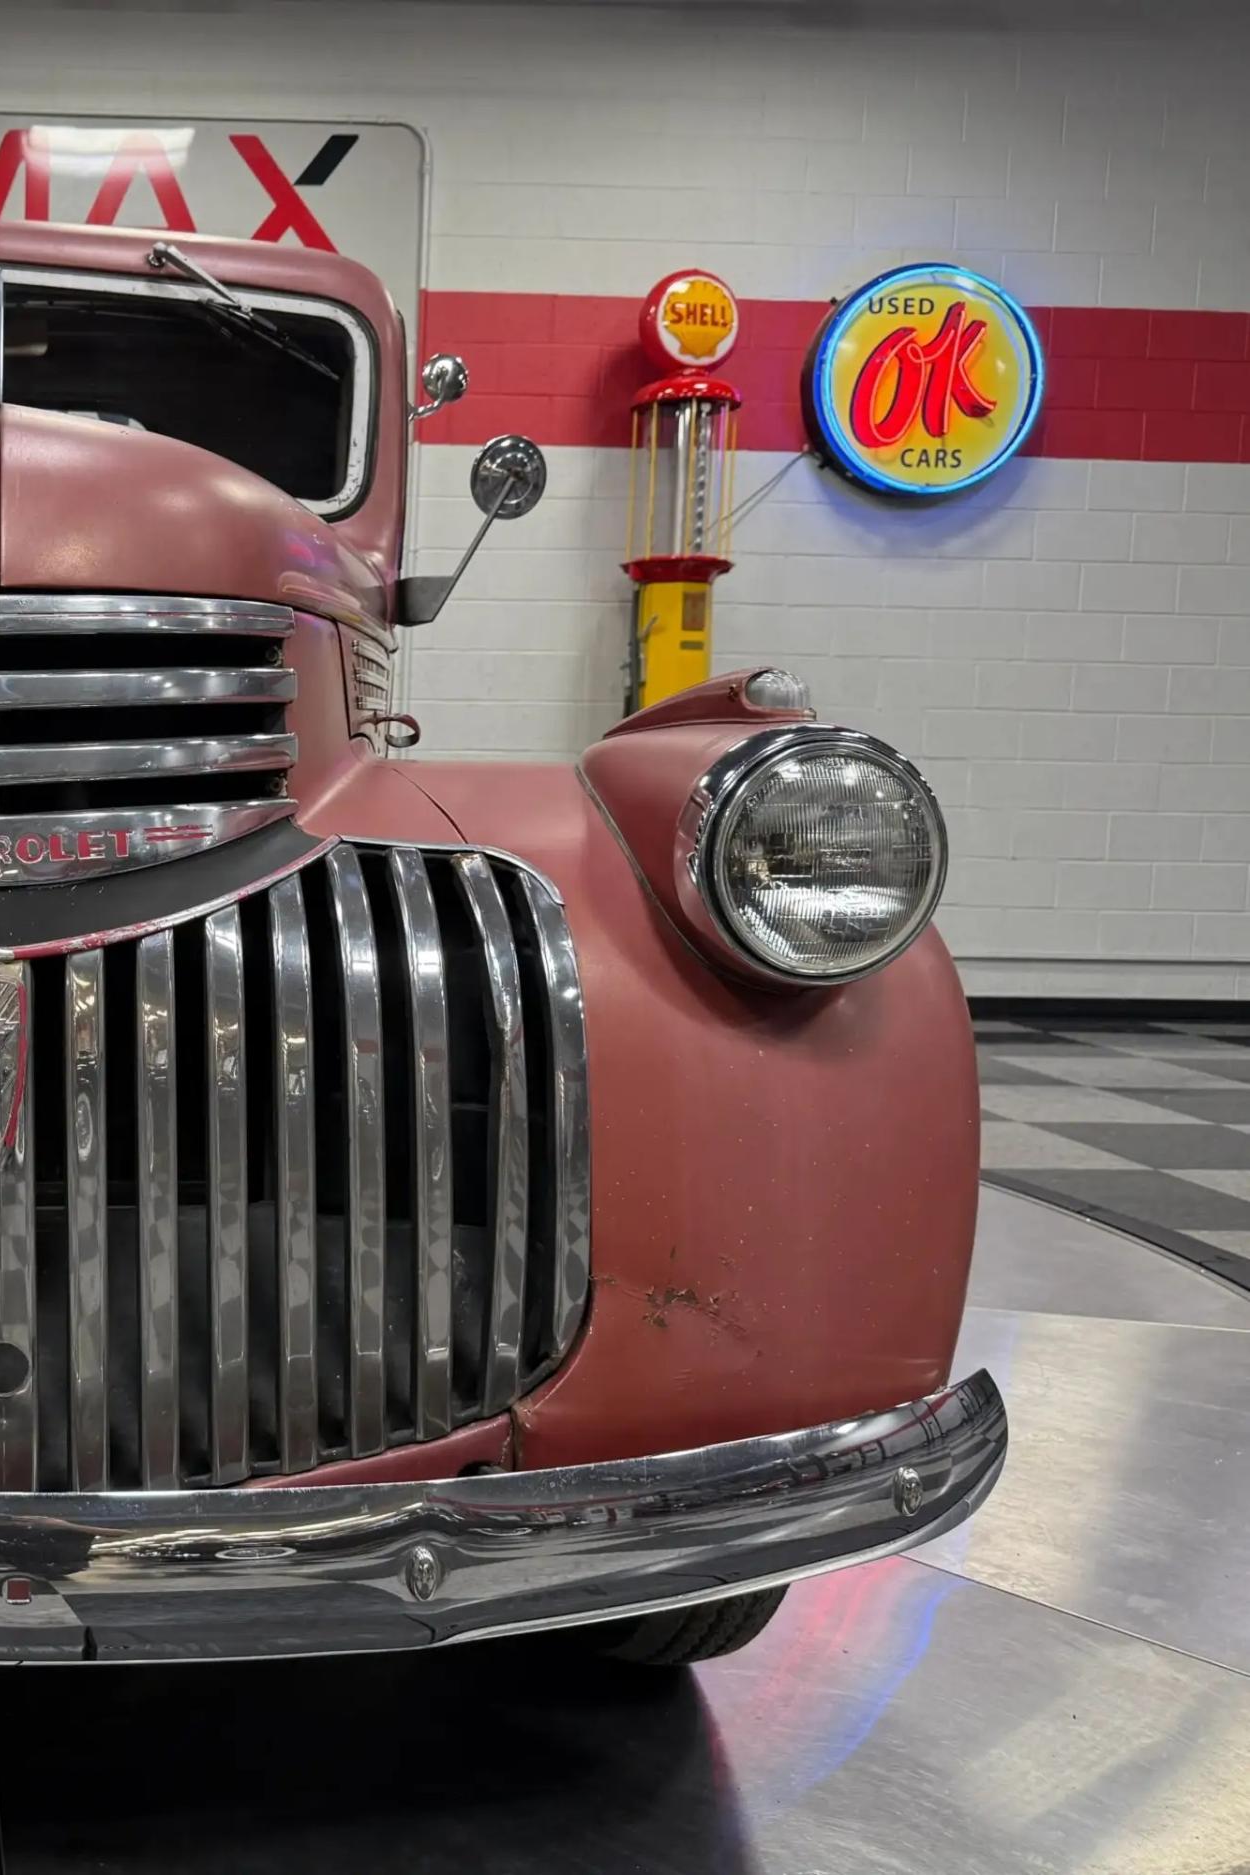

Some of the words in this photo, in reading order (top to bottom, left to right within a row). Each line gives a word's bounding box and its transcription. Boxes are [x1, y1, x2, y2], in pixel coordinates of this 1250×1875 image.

[670, 302, 729, 328] SHELL
[868, 297, 935, 316] USED
[900, 448, 963, 470] CARS
